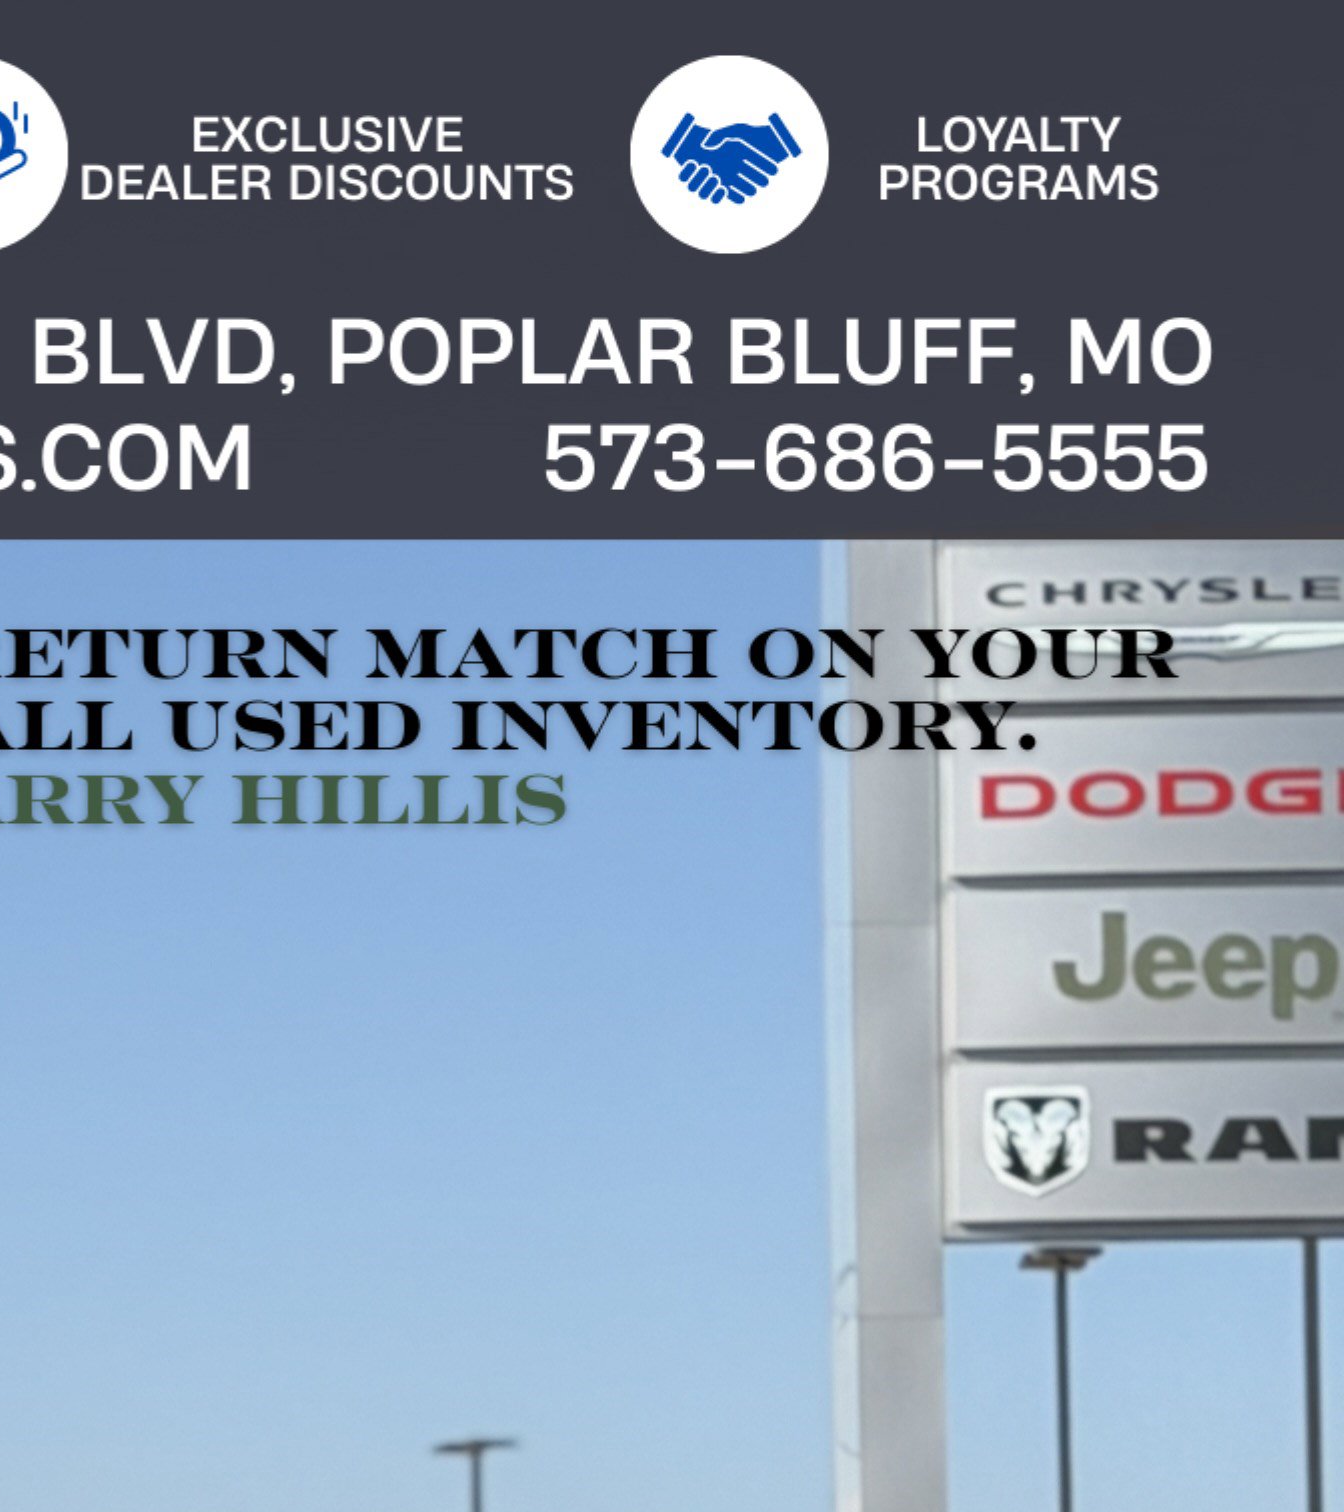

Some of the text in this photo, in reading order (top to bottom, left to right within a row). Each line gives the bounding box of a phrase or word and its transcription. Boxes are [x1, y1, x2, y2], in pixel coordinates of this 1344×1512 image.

[986, 577, 1342, 607] CHRYSLE
[980, 769, 1344, 819] DODG
[1052, 912, 1339, 1021] Jeep
